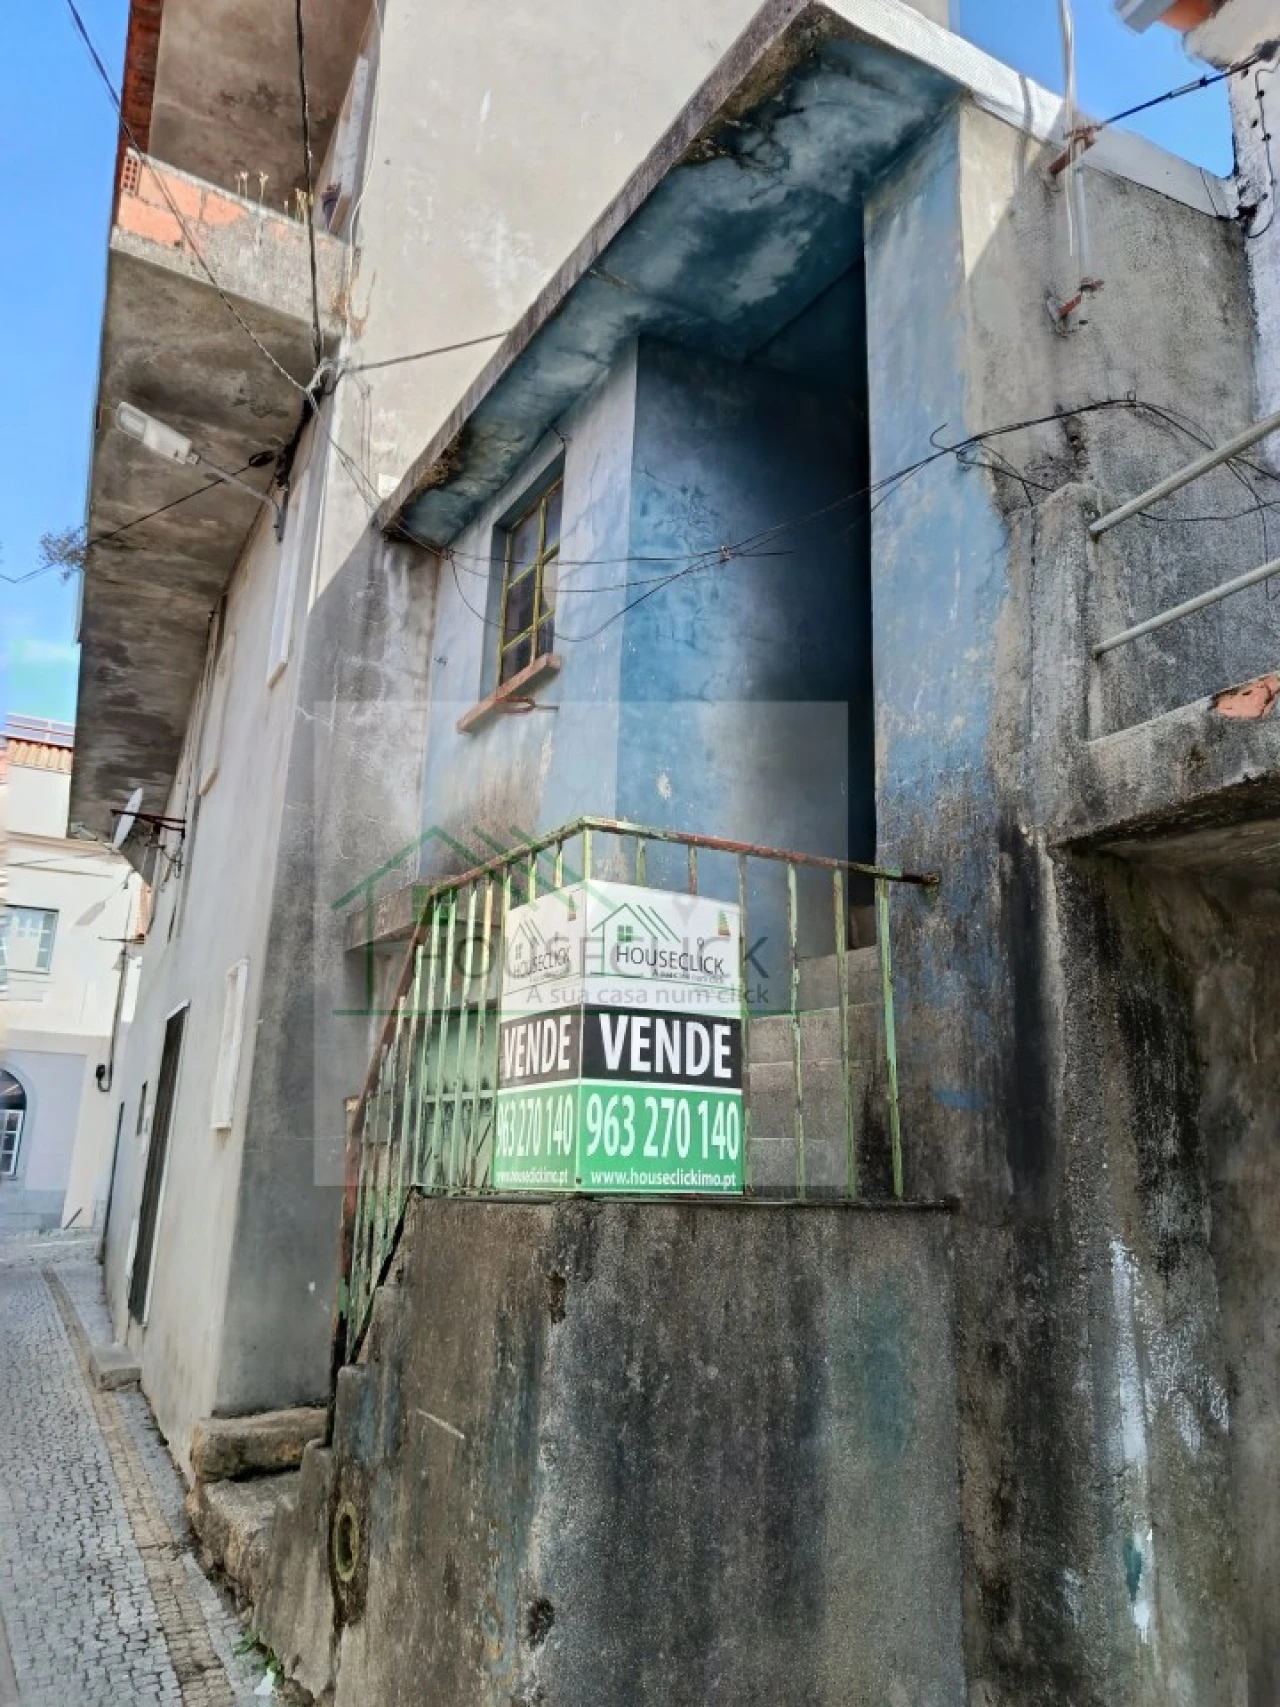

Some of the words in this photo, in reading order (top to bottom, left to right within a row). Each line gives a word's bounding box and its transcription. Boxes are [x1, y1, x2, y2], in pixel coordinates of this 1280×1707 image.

[616, 944, 725, 976] HOUSECLICK
[504, 1014, 572, 1080] VENDE
[599, 1013, 732, 1079] VENDE
[517, 1097, 541, 1157] 270
[545, 1093, 574, 1156] 140
[586, 1093, 636, 1157] 963
[643, 1095, 692, 1159] 270
[698, 1099, 742, 1161] 140
[591, 1167, 737, 1188] www.houseclickimo.pt
